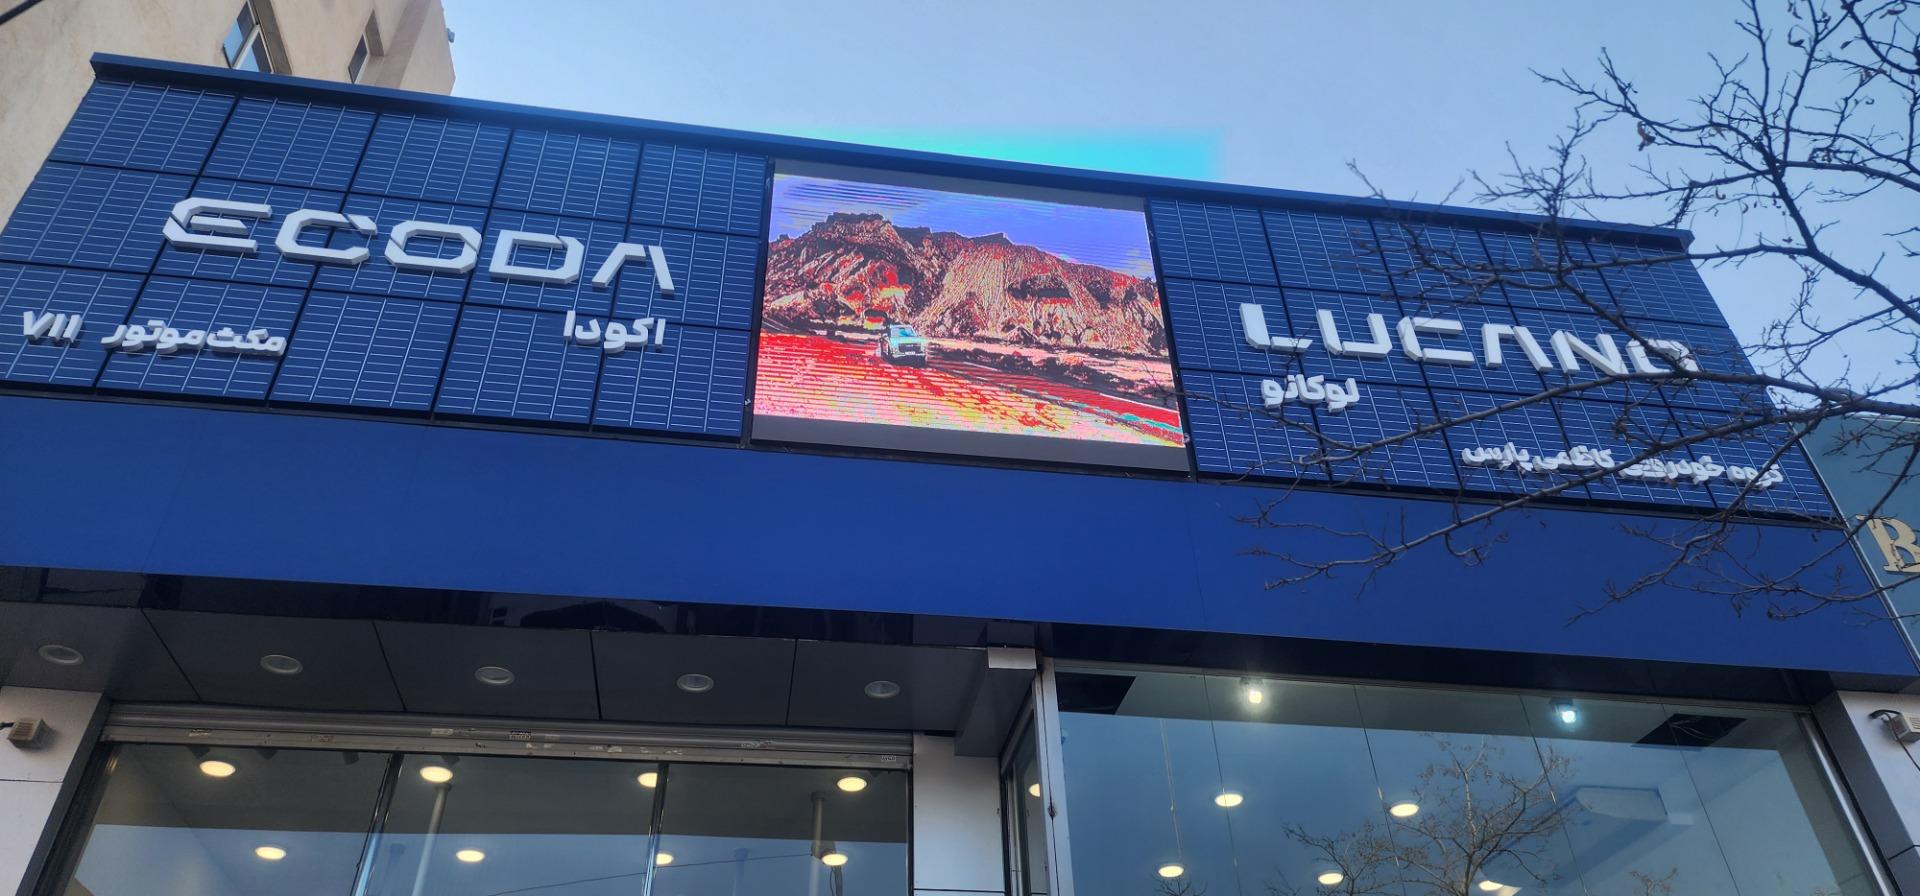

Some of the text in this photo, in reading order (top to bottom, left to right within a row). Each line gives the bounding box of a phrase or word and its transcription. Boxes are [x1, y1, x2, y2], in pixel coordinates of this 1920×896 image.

[162, 196, 675, 295] ECODA
[563, 310, 666, 354] اکودا
[1239, 303, 1699, 383] LUCANO
[1260, 373, 1361, 413] لوکانو
